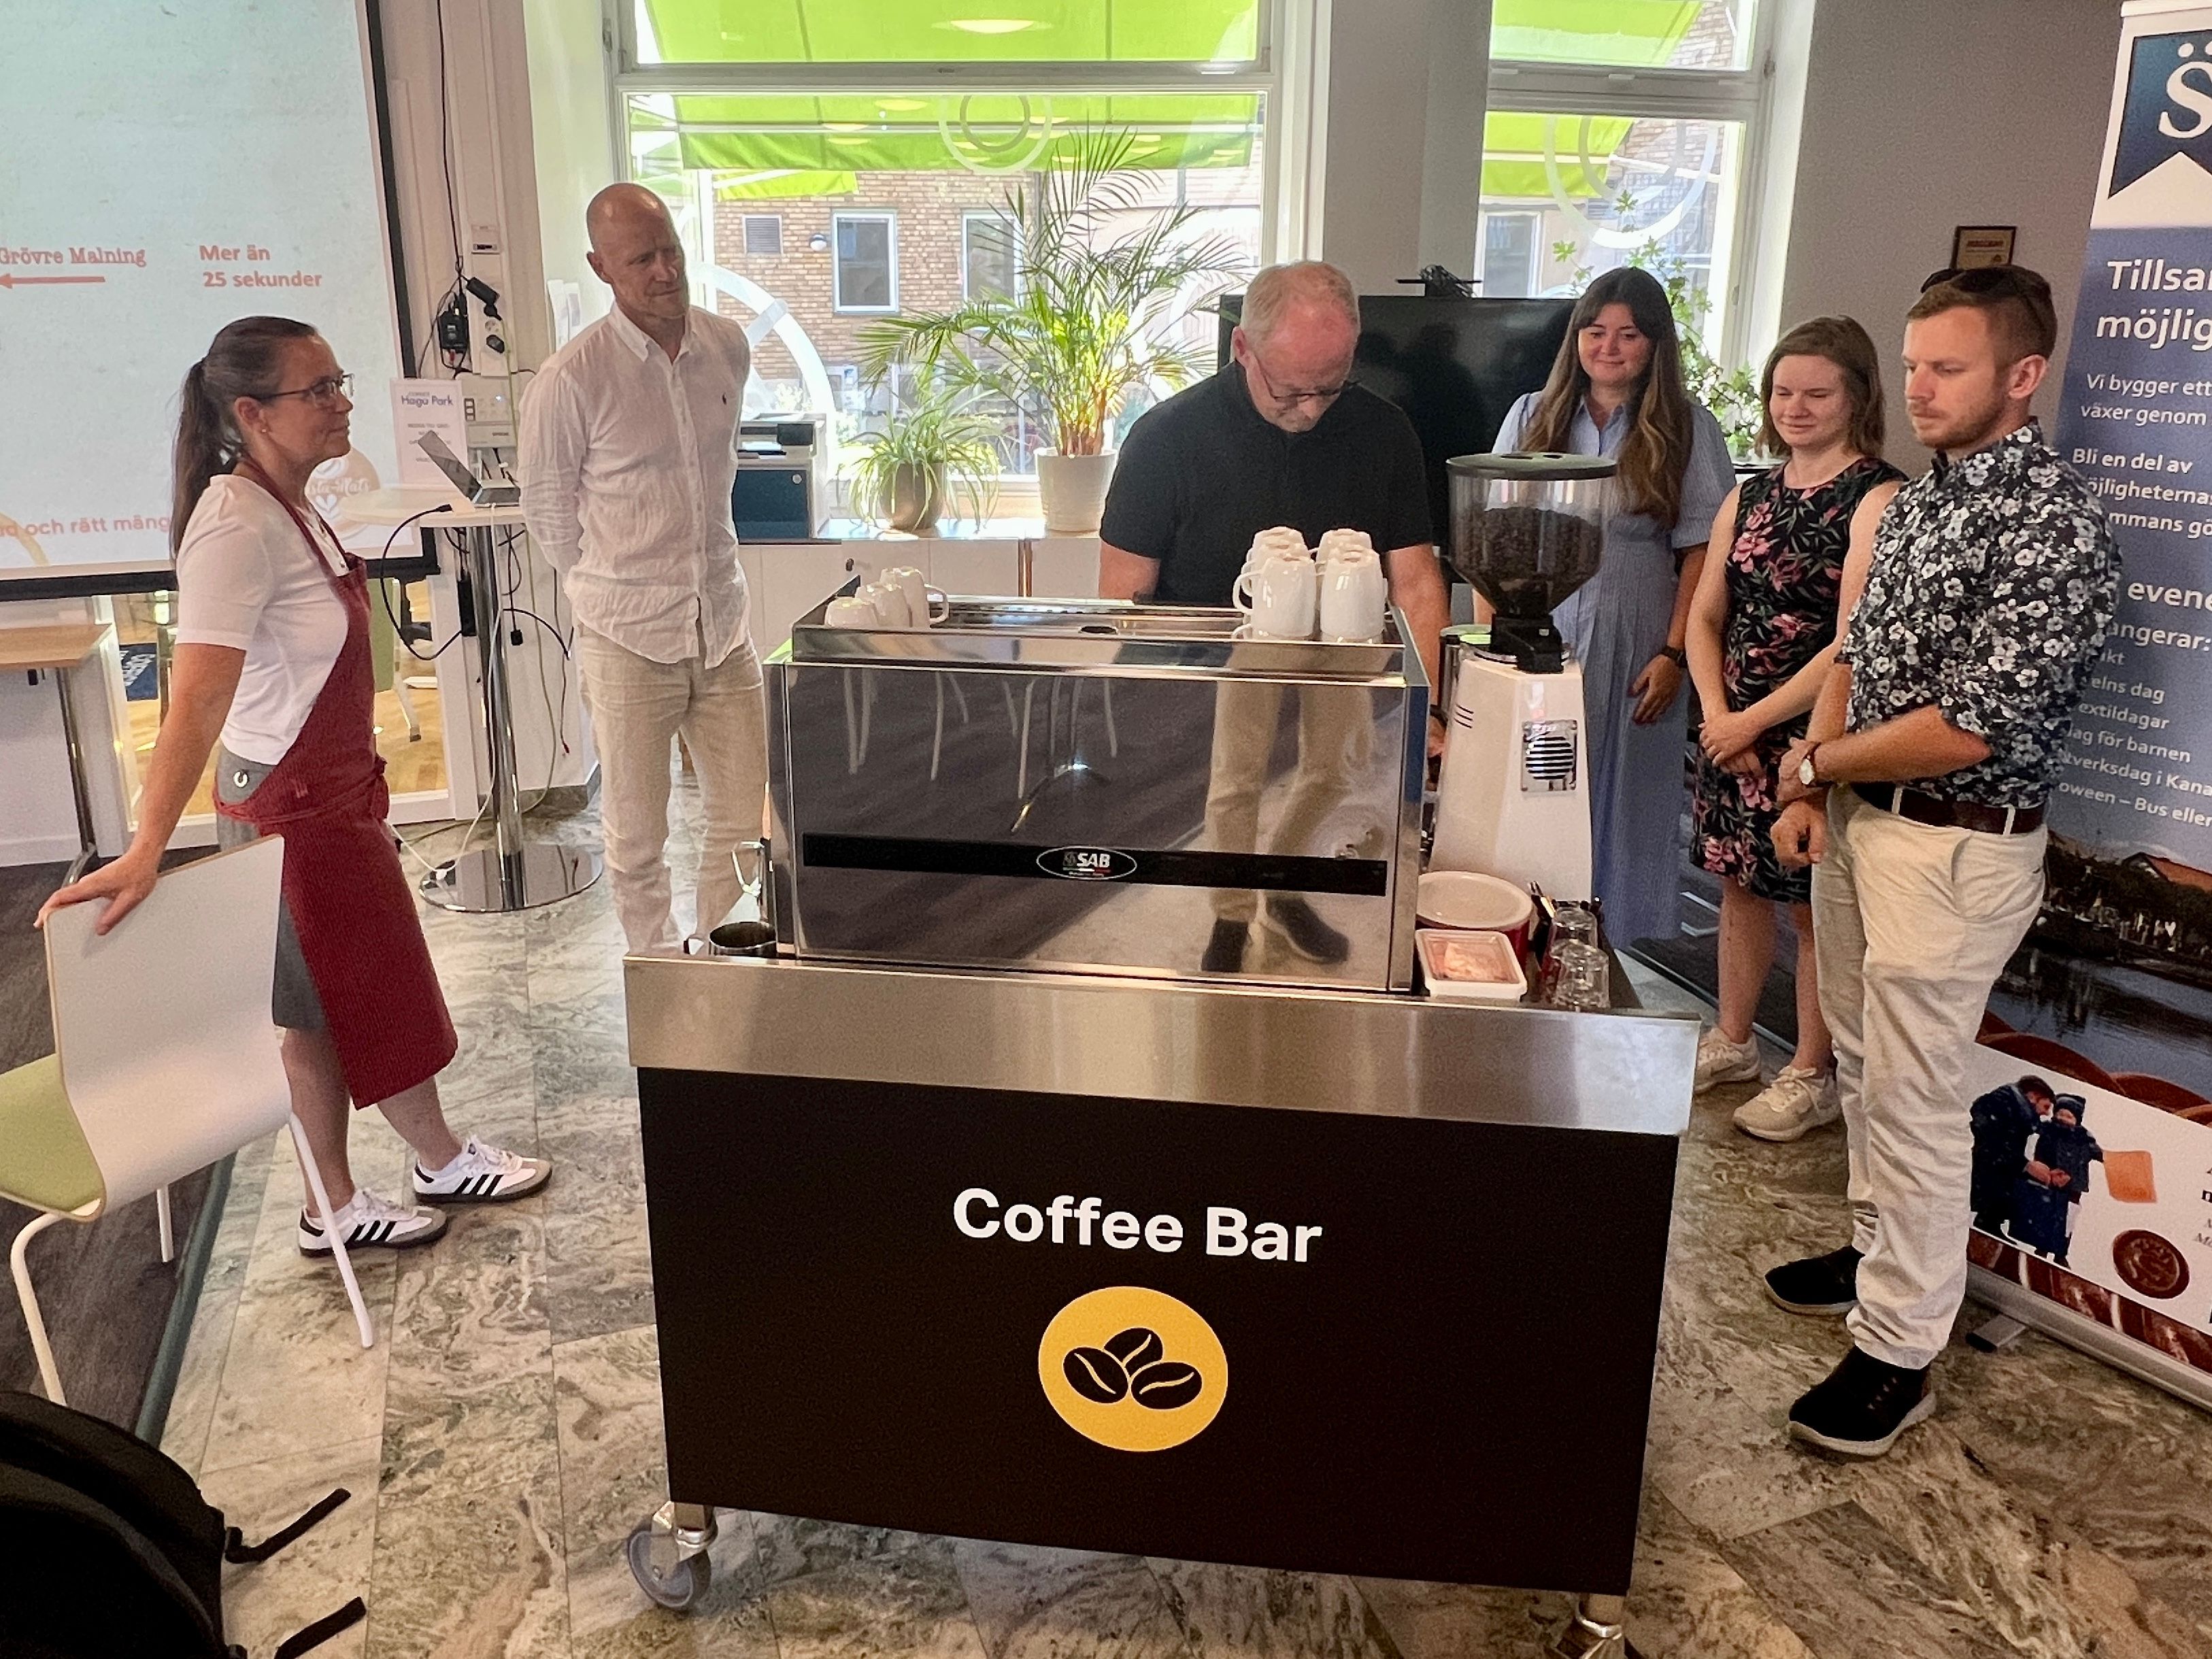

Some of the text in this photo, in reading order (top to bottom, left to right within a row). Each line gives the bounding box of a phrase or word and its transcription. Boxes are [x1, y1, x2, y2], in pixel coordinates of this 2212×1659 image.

[69, 247, 147, 267] Malning
[199, 244, 271, 261] Mer än
[203, 270, 322, 287] 25 sekunder
[2107, 258, 2212, 291] Tillsa
[2096, 308, 2212, 351] möjlig
[2087, 373, 2212, 398] Vi bygger ett
[431, 395, 453, 406] Park
[2081, 402, 2207, 427] växer genom
[2072, 448, 2194, 474] Bli en del av
[26, 519, 64, 535] och
[70, 517, 108, 534] rätt
[2130, 682, 2166, 705] dag
[2098, 730, 2124, 748] för
[2126, 735, 2190, 763] barnen
[2156, 770, 2163, 785] i
[2134, 797, 2168, 817] Bus
[2172, 807, 2212, 827] eller
[953, 1188, 1322, 1262] Coffee Bar
